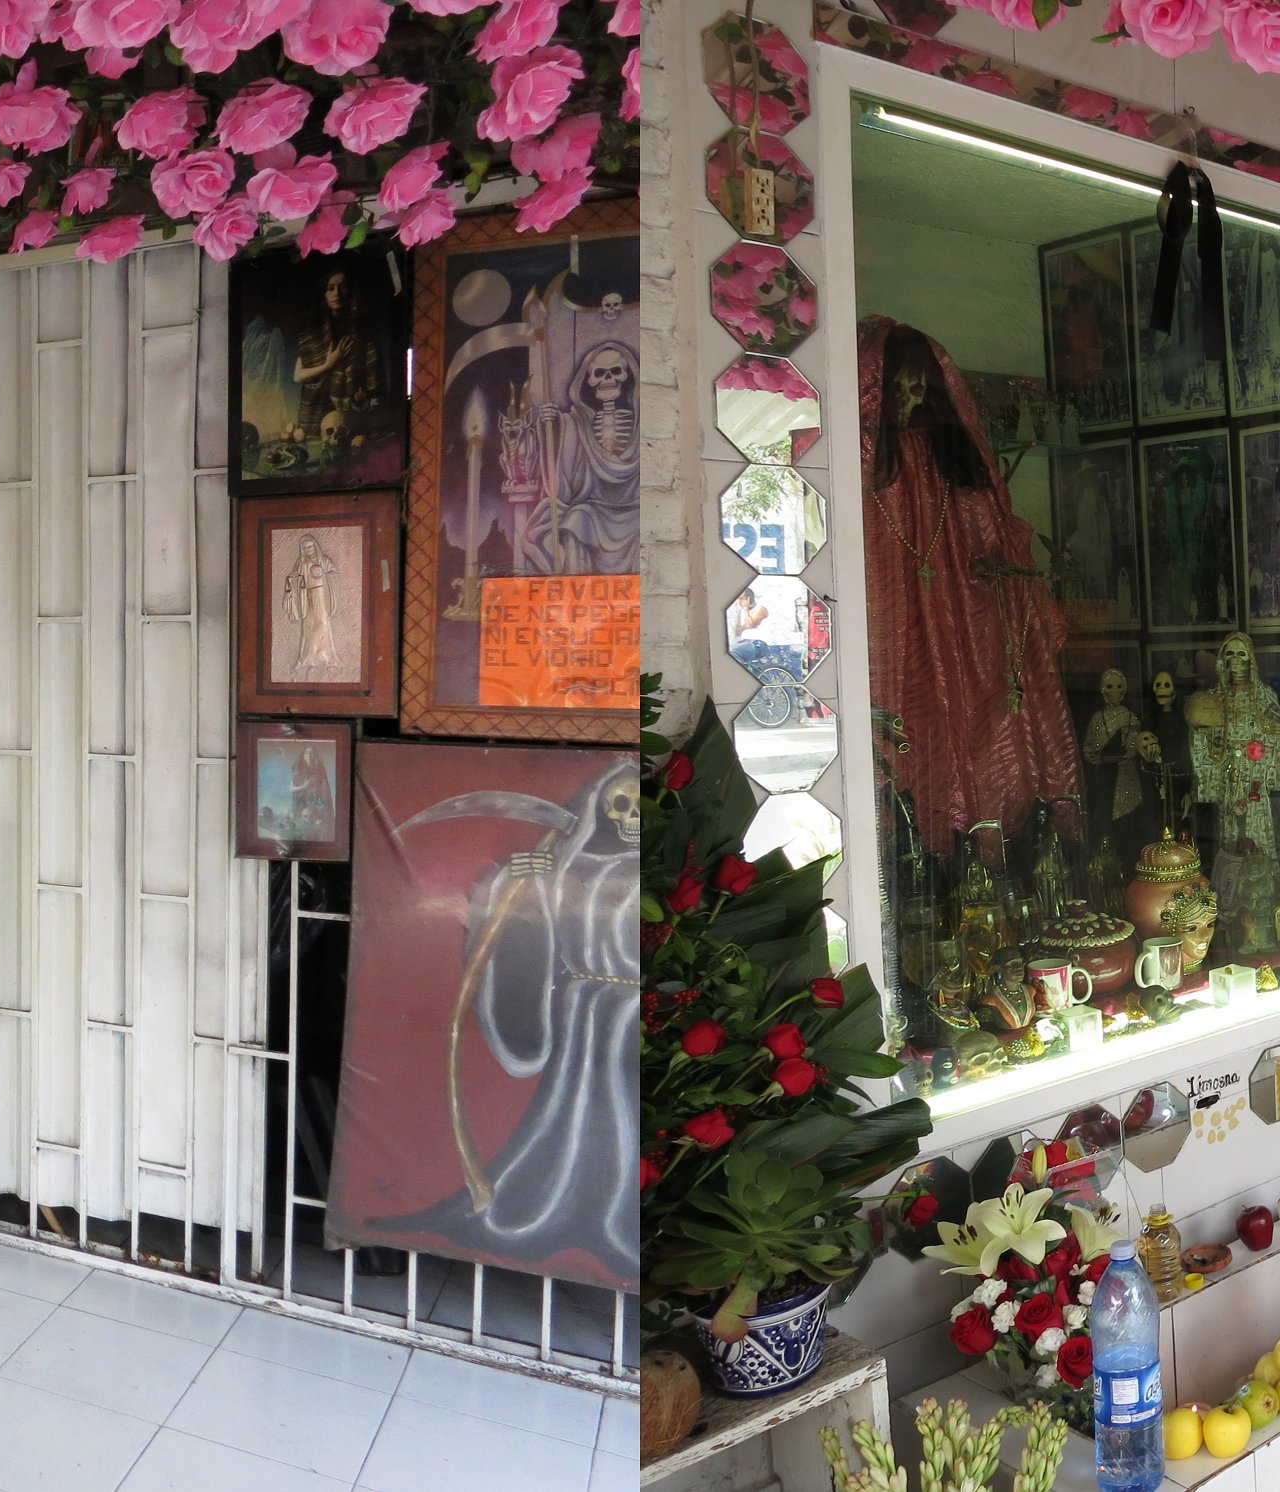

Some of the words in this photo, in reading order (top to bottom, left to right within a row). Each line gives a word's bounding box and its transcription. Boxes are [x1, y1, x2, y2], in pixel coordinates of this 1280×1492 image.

[528, 579, 633, 601] FAVOR
[485, 604, 521, 623] DE
[526, 604, 564, 623] NO
[484, 626, 508, 645] NI
[484, 648, 519, 667] EL
[552, 676, 640, 697] GRACI
[1186, 1072, 1241, 1099] Limosna
